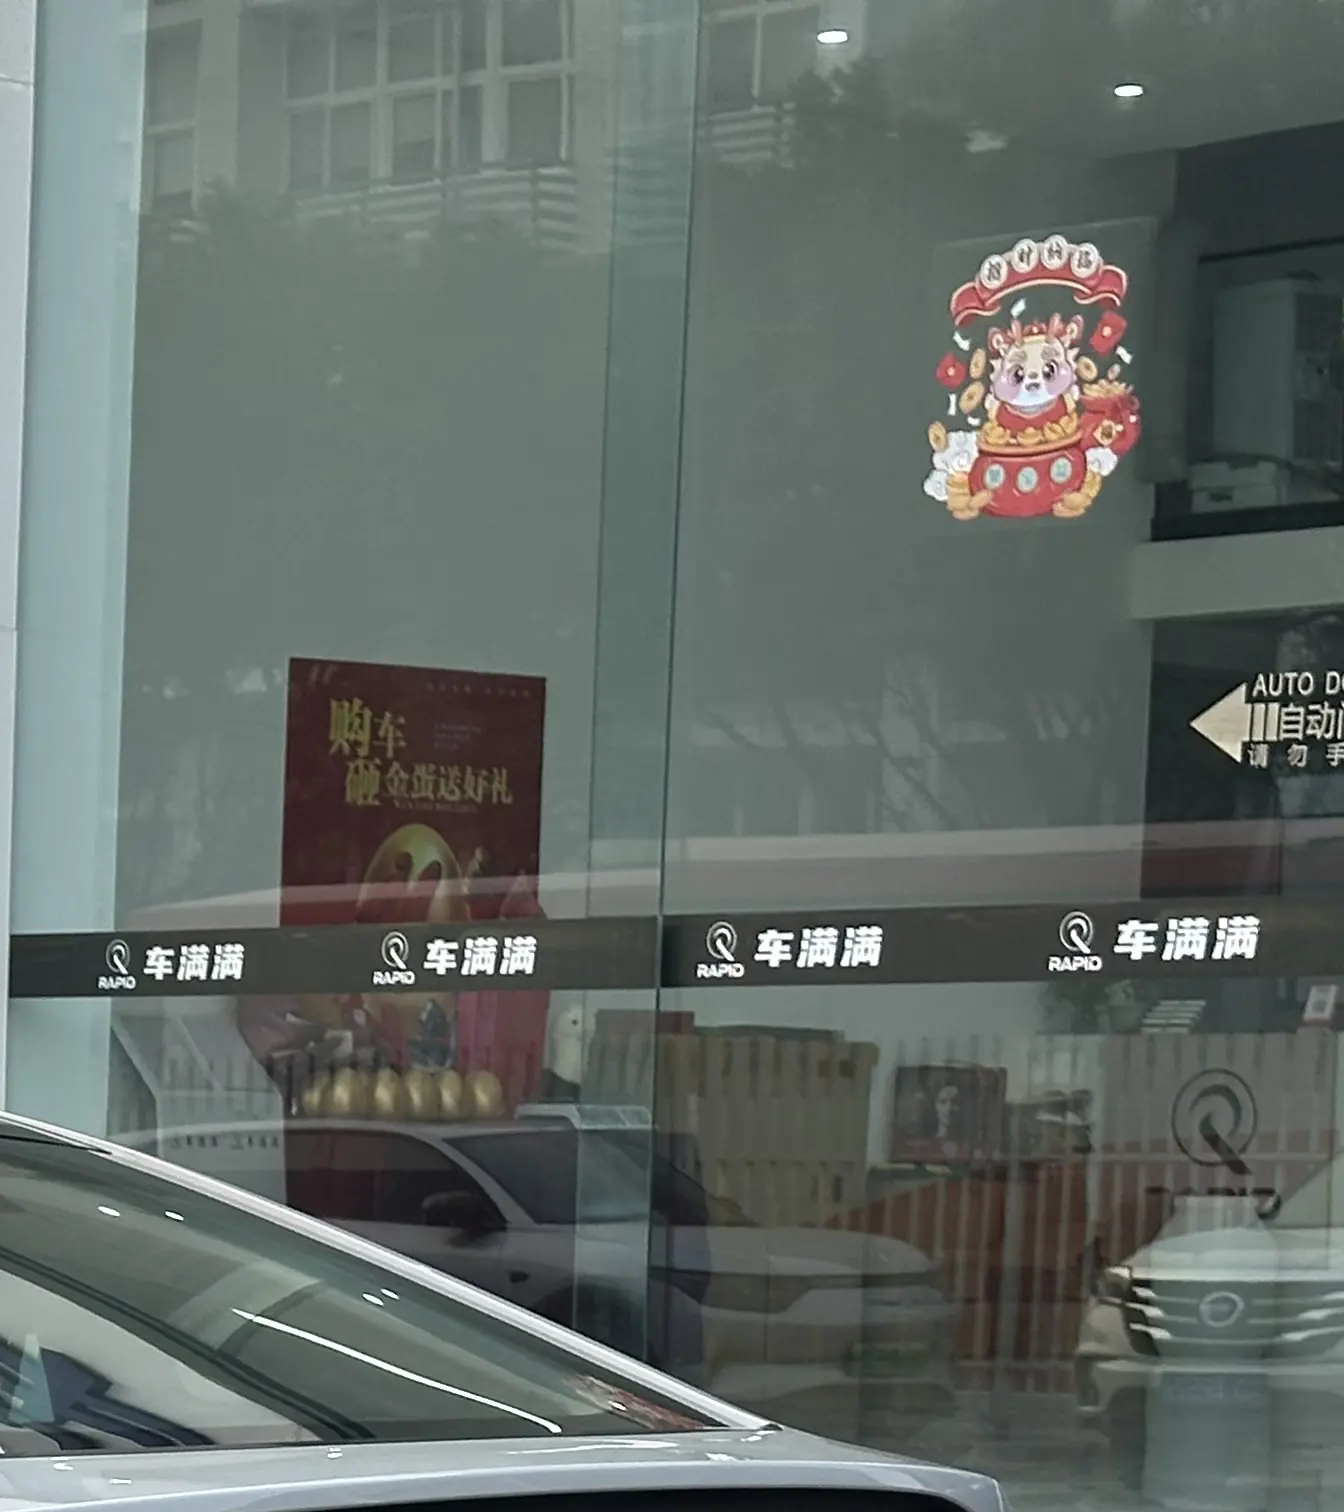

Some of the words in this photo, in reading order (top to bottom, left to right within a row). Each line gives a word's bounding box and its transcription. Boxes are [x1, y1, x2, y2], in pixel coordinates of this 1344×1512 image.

[1252, 672, 1314, 697] AUTO
[1325, 671, 1344, 695] D
[329, 697, 407, 758] 购车
[1279, 702, 1344, 741] 自动
[423, 935, 537, 975] 车满满
[754, 926, 883, 967] 车满满
[1113, 915, 1260, 960] 车满满
[143, 943, 244, 980] 车满满
[373, 971, 415, 985] RAPID
[696, 963, 744, 978] RAPID
[1048, 956, 1102, 971] RAPID
